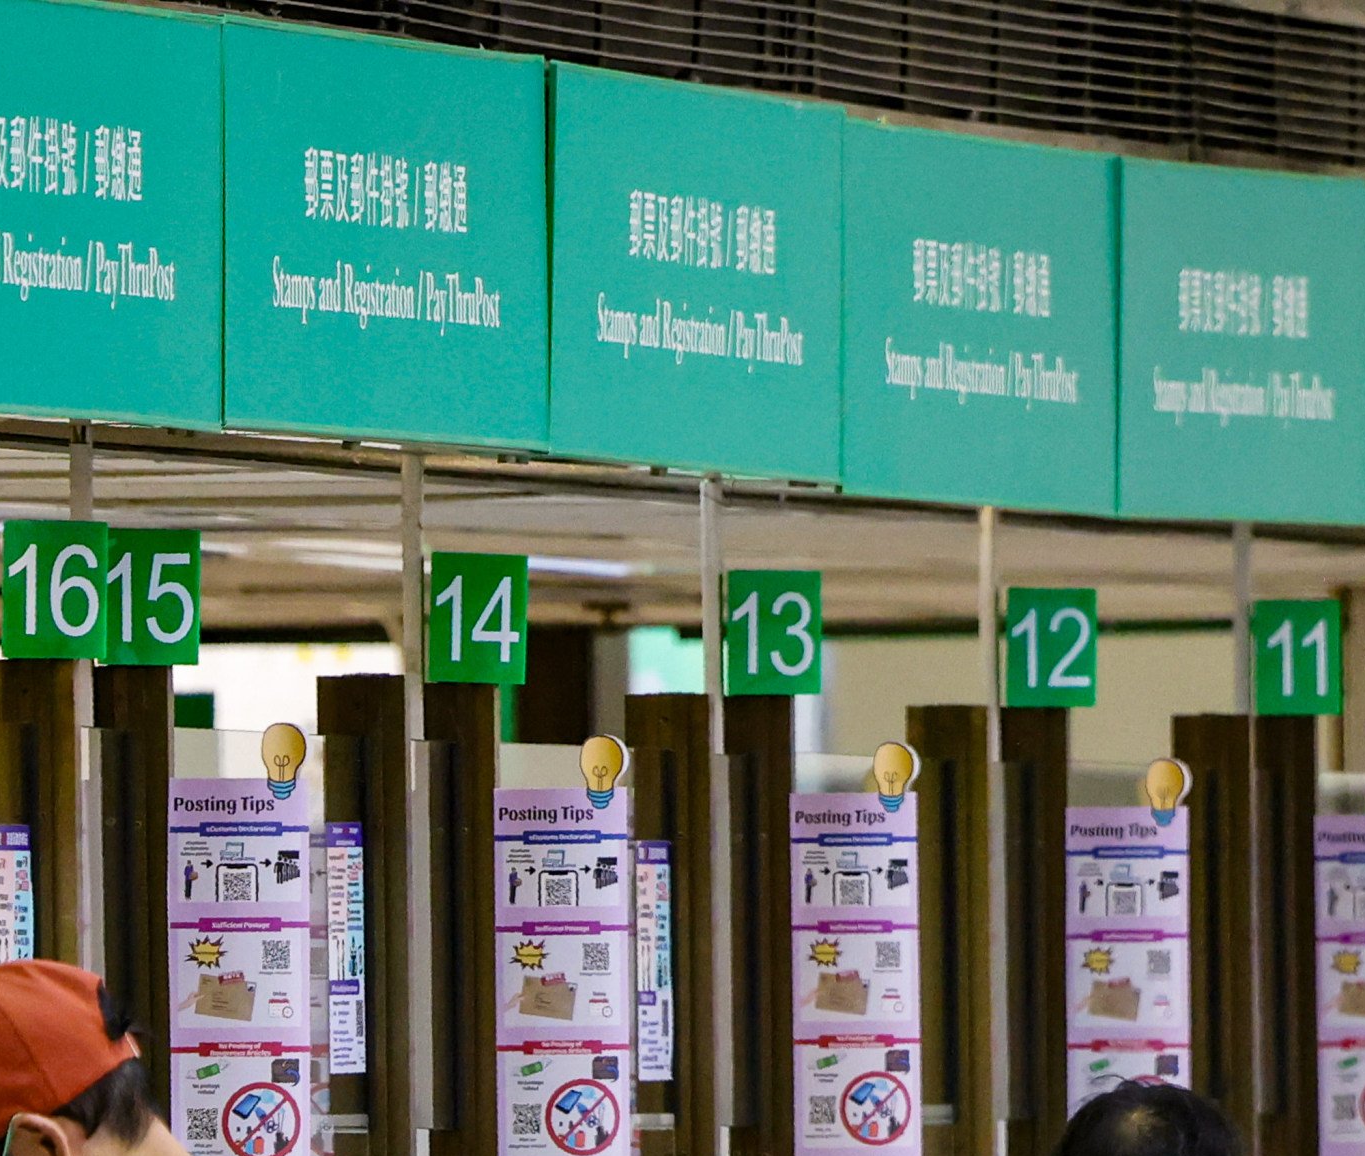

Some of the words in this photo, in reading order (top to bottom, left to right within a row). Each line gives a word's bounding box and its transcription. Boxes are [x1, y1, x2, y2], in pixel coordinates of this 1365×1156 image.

[2, 232, 83, 301] Registration
[272, 255, 316, 325] Stamps
[319, 259, 342, 312] and
[344, 263, 415, 330] Registration
[597, 291, 637, 359] Stamps
[639, 298, 661, 349] and
[662, 301, 726, 365] Registration
[924, 341, 944, 389] and
[8, 544, 100, 637] 16
[107, 552, 195, 644] 15
[435, 575, 520, 663] 14
[732, 591, 815, 676] 13
[1011, 607, 1092, 688] 12
[1266, 619, 1330, 698] 11
[173, 796, 237, 815] Posting
[241, 796, 275, 815] Tips
[498, 807, 558, 823] Posting
[563, 806, 594, 823] Tips
[794, 811, 851, 826] Posting
[855, 810, 886, 825] Tips
[1069, 824, 1125, 840] Posting
